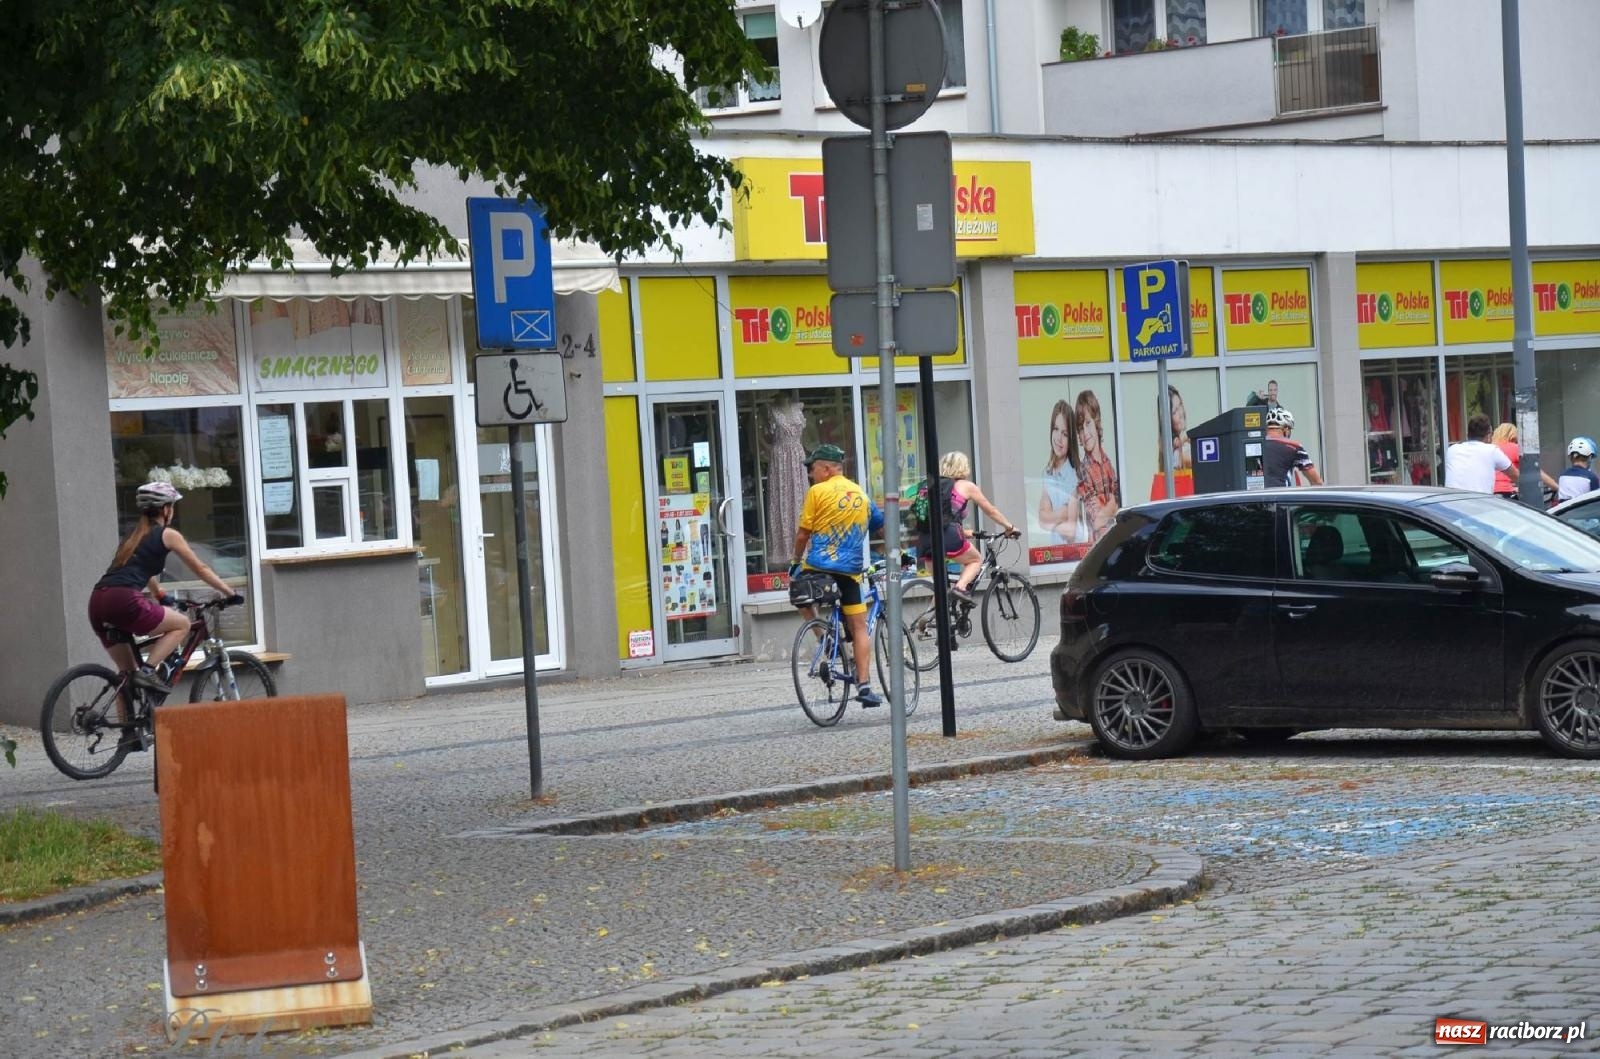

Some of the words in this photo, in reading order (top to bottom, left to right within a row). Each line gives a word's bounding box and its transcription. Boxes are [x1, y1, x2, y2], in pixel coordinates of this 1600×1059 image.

[489, 211, 536, 304] P
[1138, 268, 1166, 310] P
[1395, 290, 1430, 310] Polska
[1270, 290, 1307, 311] Polska
[1063, 301, 1103, 324] Polska
[562, 333, 596, 359] 2-4
[1132, 344, 1179, 357] PARKOMAT
[260, 353, 380, 379] SMACZNEGO
[149, 371, 189, 386] Napoje
[1201, 439, 1216, 460] P
